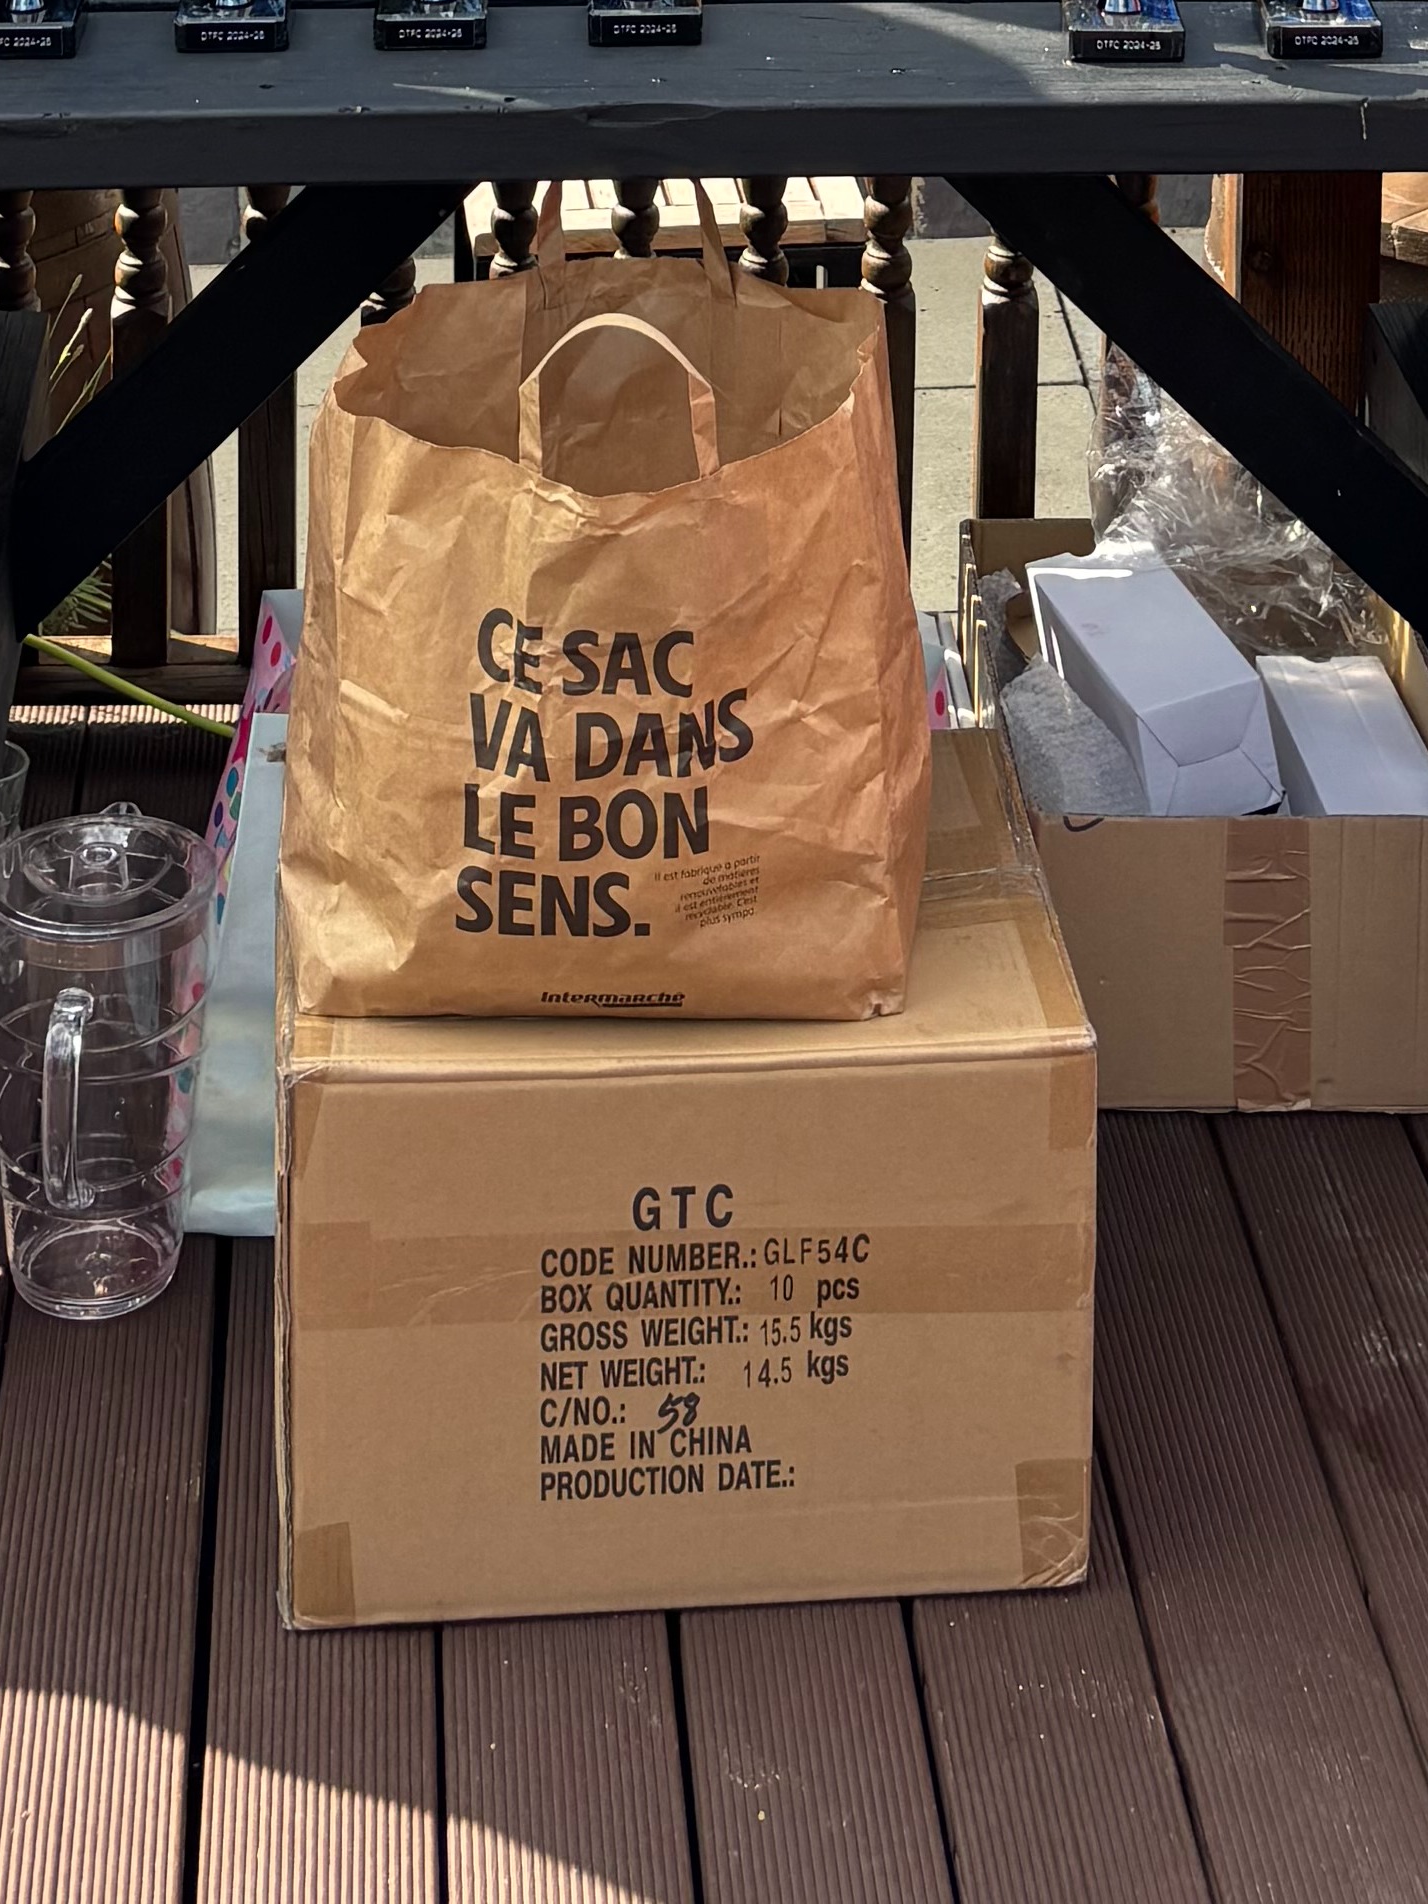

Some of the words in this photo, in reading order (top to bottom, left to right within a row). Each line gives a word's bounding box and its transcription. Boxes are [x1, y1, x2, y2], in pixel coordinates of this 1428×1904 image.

[477, 607, 543, 693] CE
[561, 629, 695, 698] SAC
[468, 692, 551, 782] VA
[574, 687, 755, 781] DANS
[463, 782, 536, 860] LE
[559, 785, 710, 862] BON
[454, 866, 652, 939] SENS.
[632, 1184, 734, 1231] GTC
[540, 1246, 614, 1279] CODE
[763, 1234, 871, 1268] GLF54C
[540, 1282, 593, 1315] BOX
[769, 1274, 794, 1302] 10
[816, 1274, 861, 1310] pcs
[540, 1319, 628, 1353] GROSS
[759, 1316, 802, 1347] 15.5
[809, 1310, 853, 1345] kgs
[540, 1359, 588, 1391] NET
[742, 1357, 792, 1389] 14.5
[806, 1350, 849, 1385] kgs
[540, 1396, 626, 1429] C/NO.:
[540, 1431, 615, 1465] MADE
[629, 1430, 655, 1460] IN
[671, 1424, 752, 1458] CHINA
[540, 1464, 705, 1503] PRODUCTION
